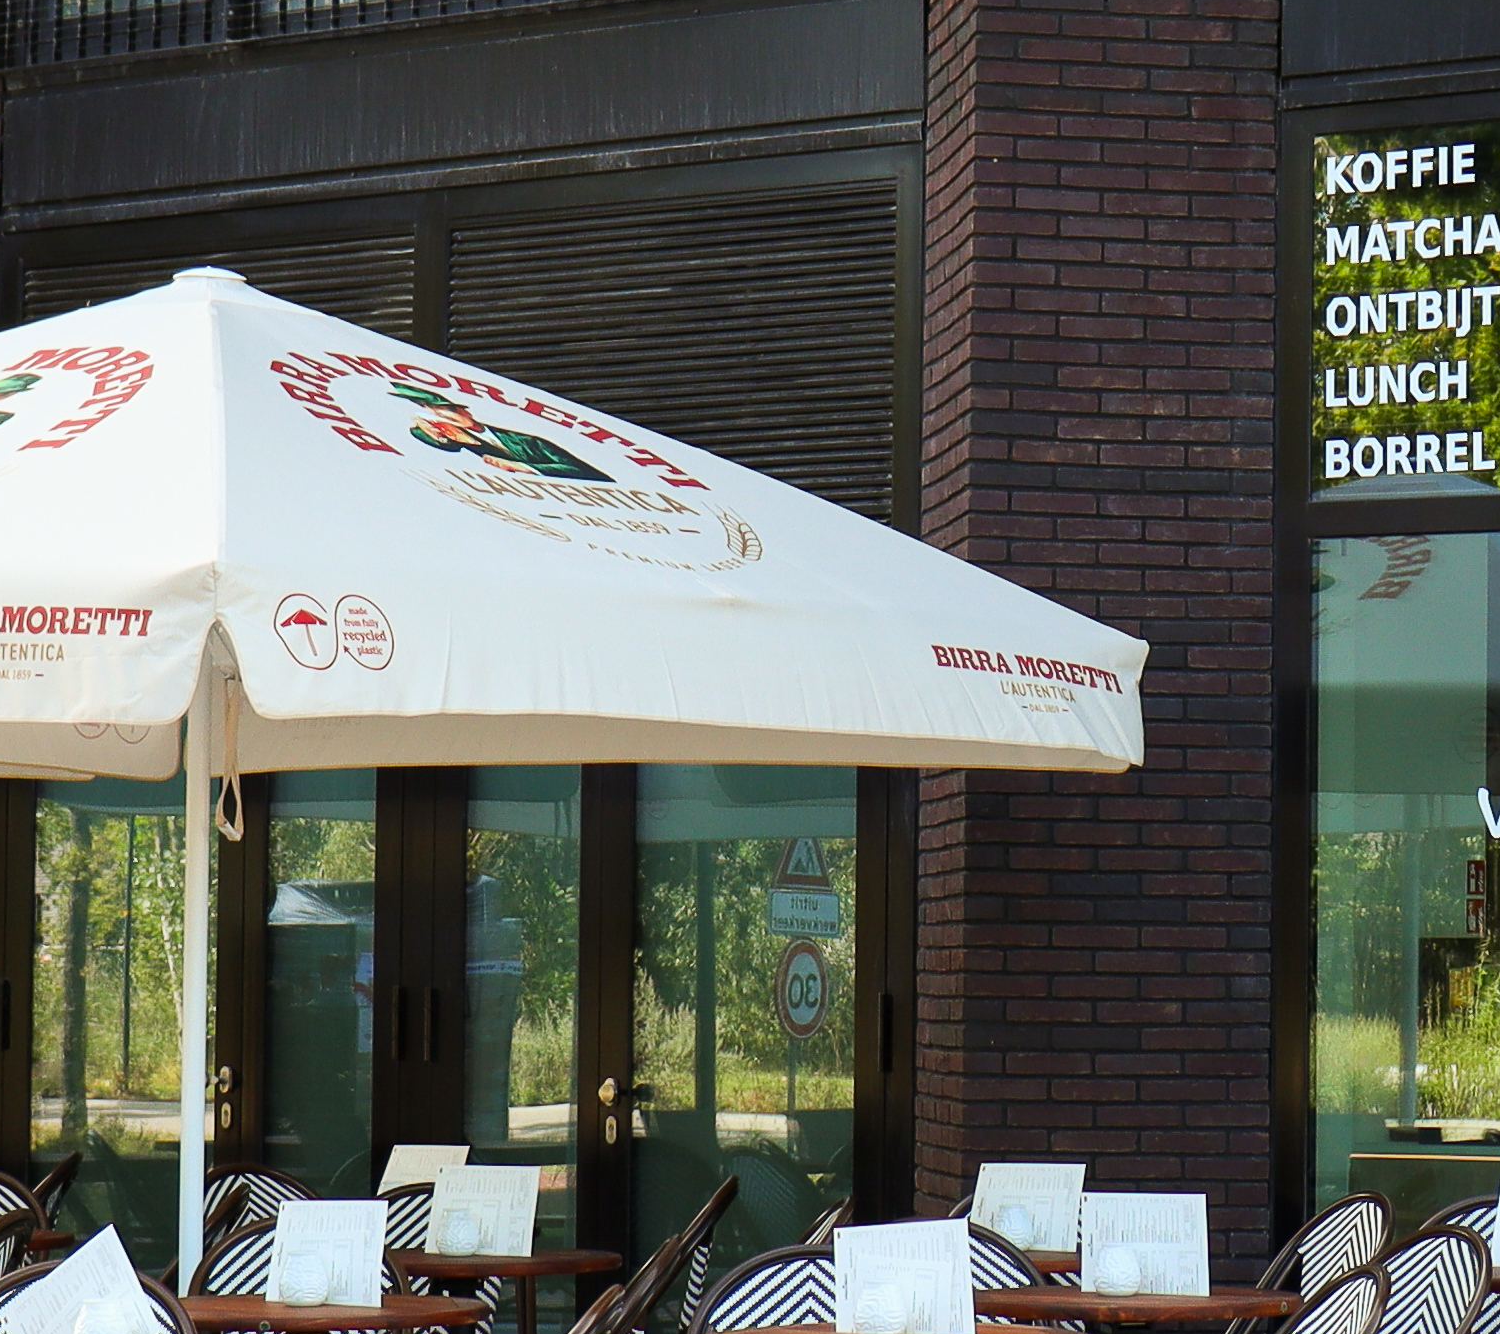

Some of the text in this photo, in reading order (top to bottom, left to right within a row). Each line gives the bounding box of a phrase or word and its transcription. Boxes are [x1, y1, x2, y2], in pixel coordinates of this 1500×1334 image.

[1326, 144, 1476, 195] KOFFIE
[1325, 285, 1500, 338] ONTBIJT
[0, 346, 155, 452] MORETTI
[1325, 360, 1468, 408] LUNCH
[270, 351, 711, 491] BIRRA MORETTI
[1325, 431, 1496, 480] BORREL
[444, 468, 702, 517] L'AUTENTICA
[565, 513, 673, 535] DAL 1859
[0, 605, 153, 636] MORETTI
[342, 629, 387, 644] recycled
[12, 669, 31, 680] 1859
[357, 645, 383, 656] plastic
[931, 644, 1124, 694] BIRRA MORETTI
[1000, 680, 1076, 703] L'AUTENTICA
